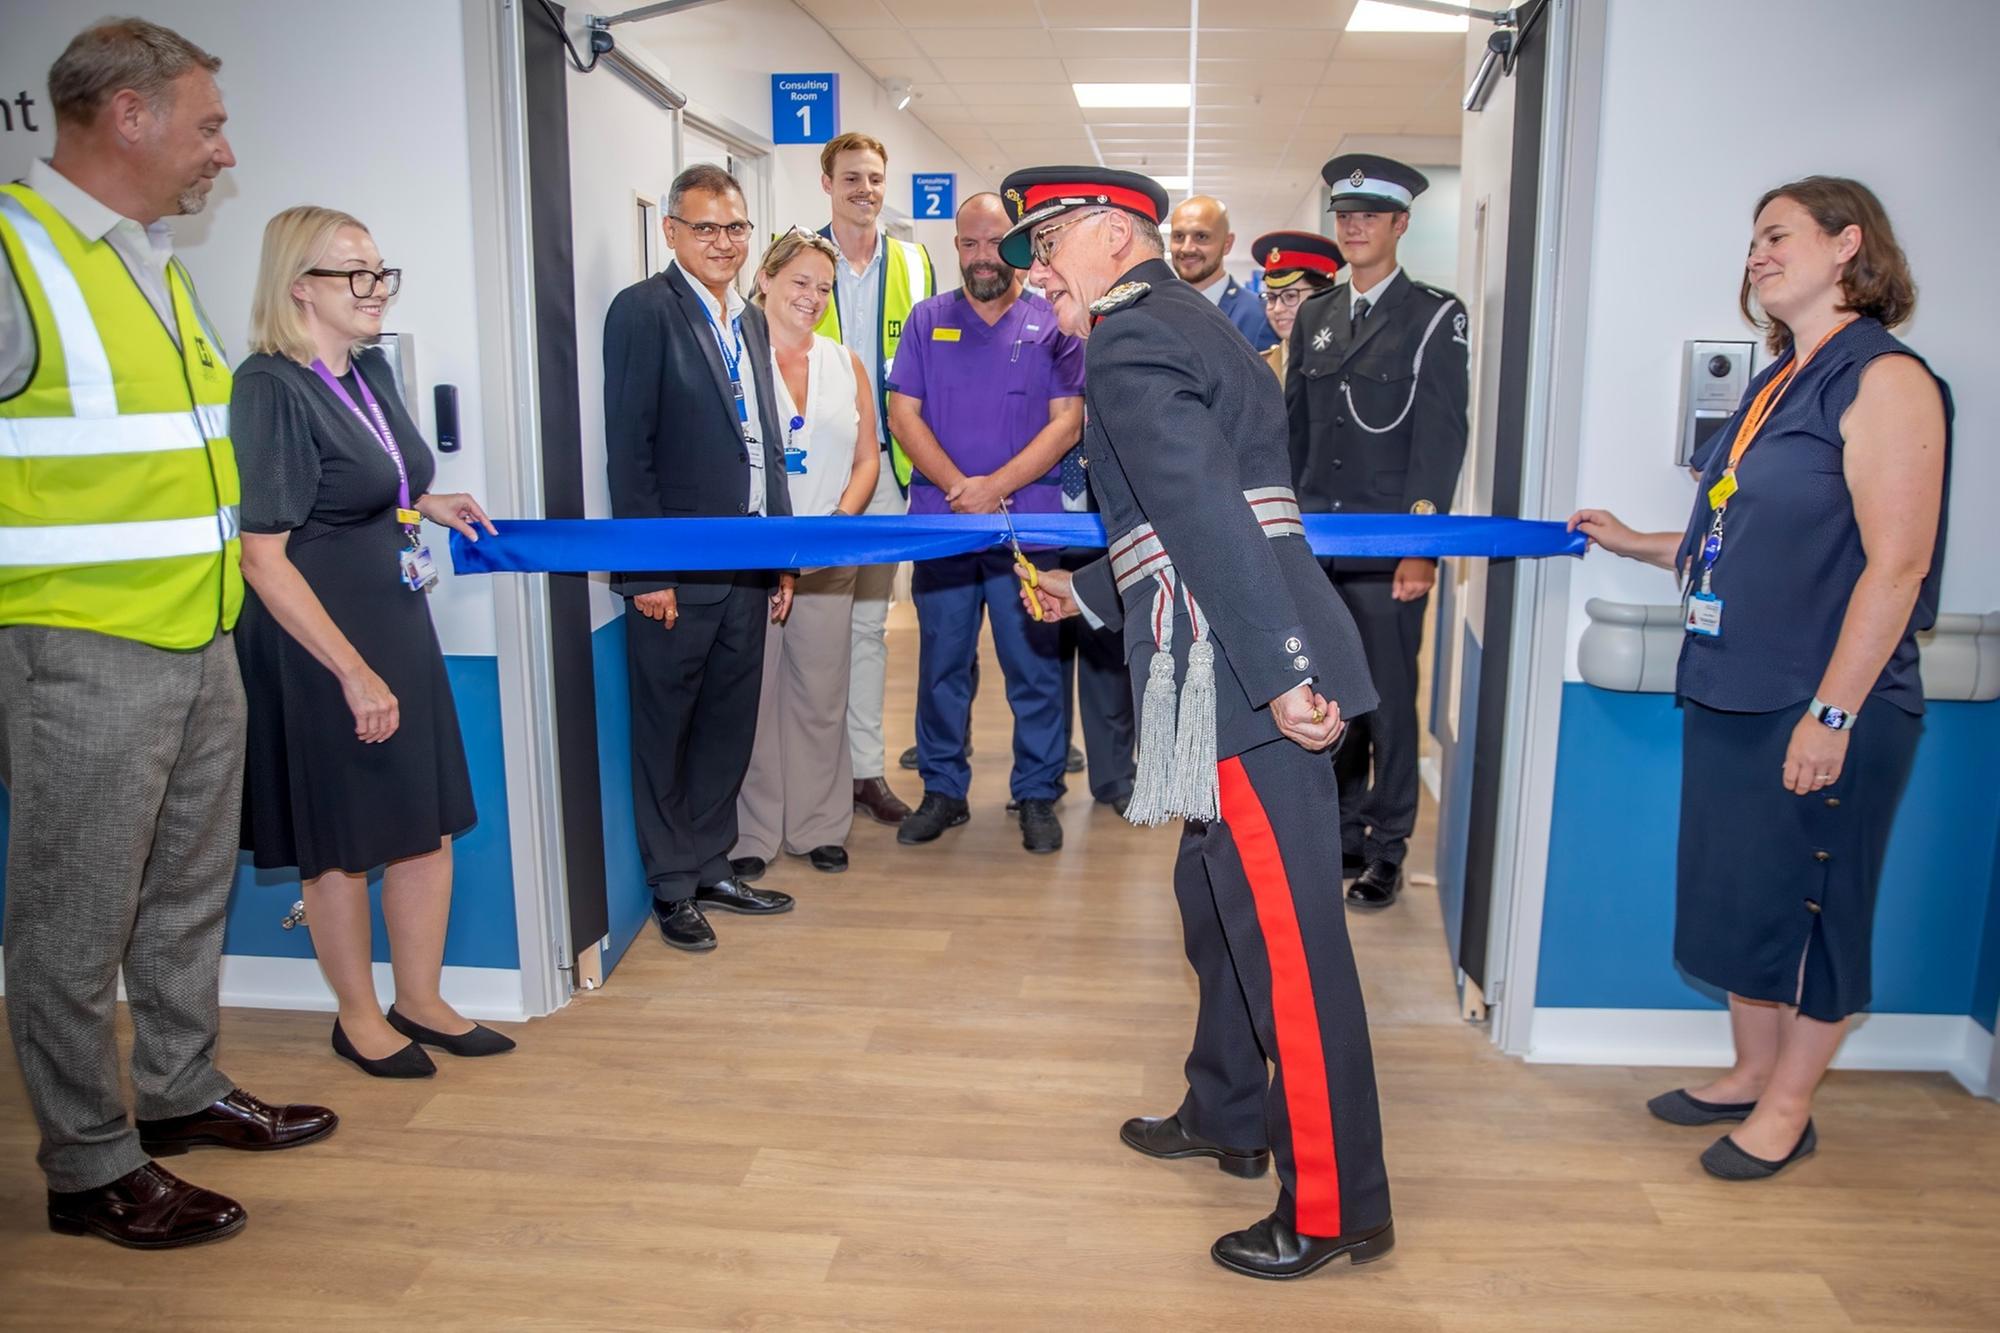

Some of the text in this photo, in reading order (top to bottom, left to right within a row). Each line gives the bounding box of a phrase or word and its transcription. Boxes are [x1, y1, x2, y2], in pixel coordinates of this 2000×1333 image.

[779, 80, 829, 92] Consulting
[790, 91, 818, 101] Room
[796, 105, 811, 137] 1
[926, 193, 941, 216] 2
